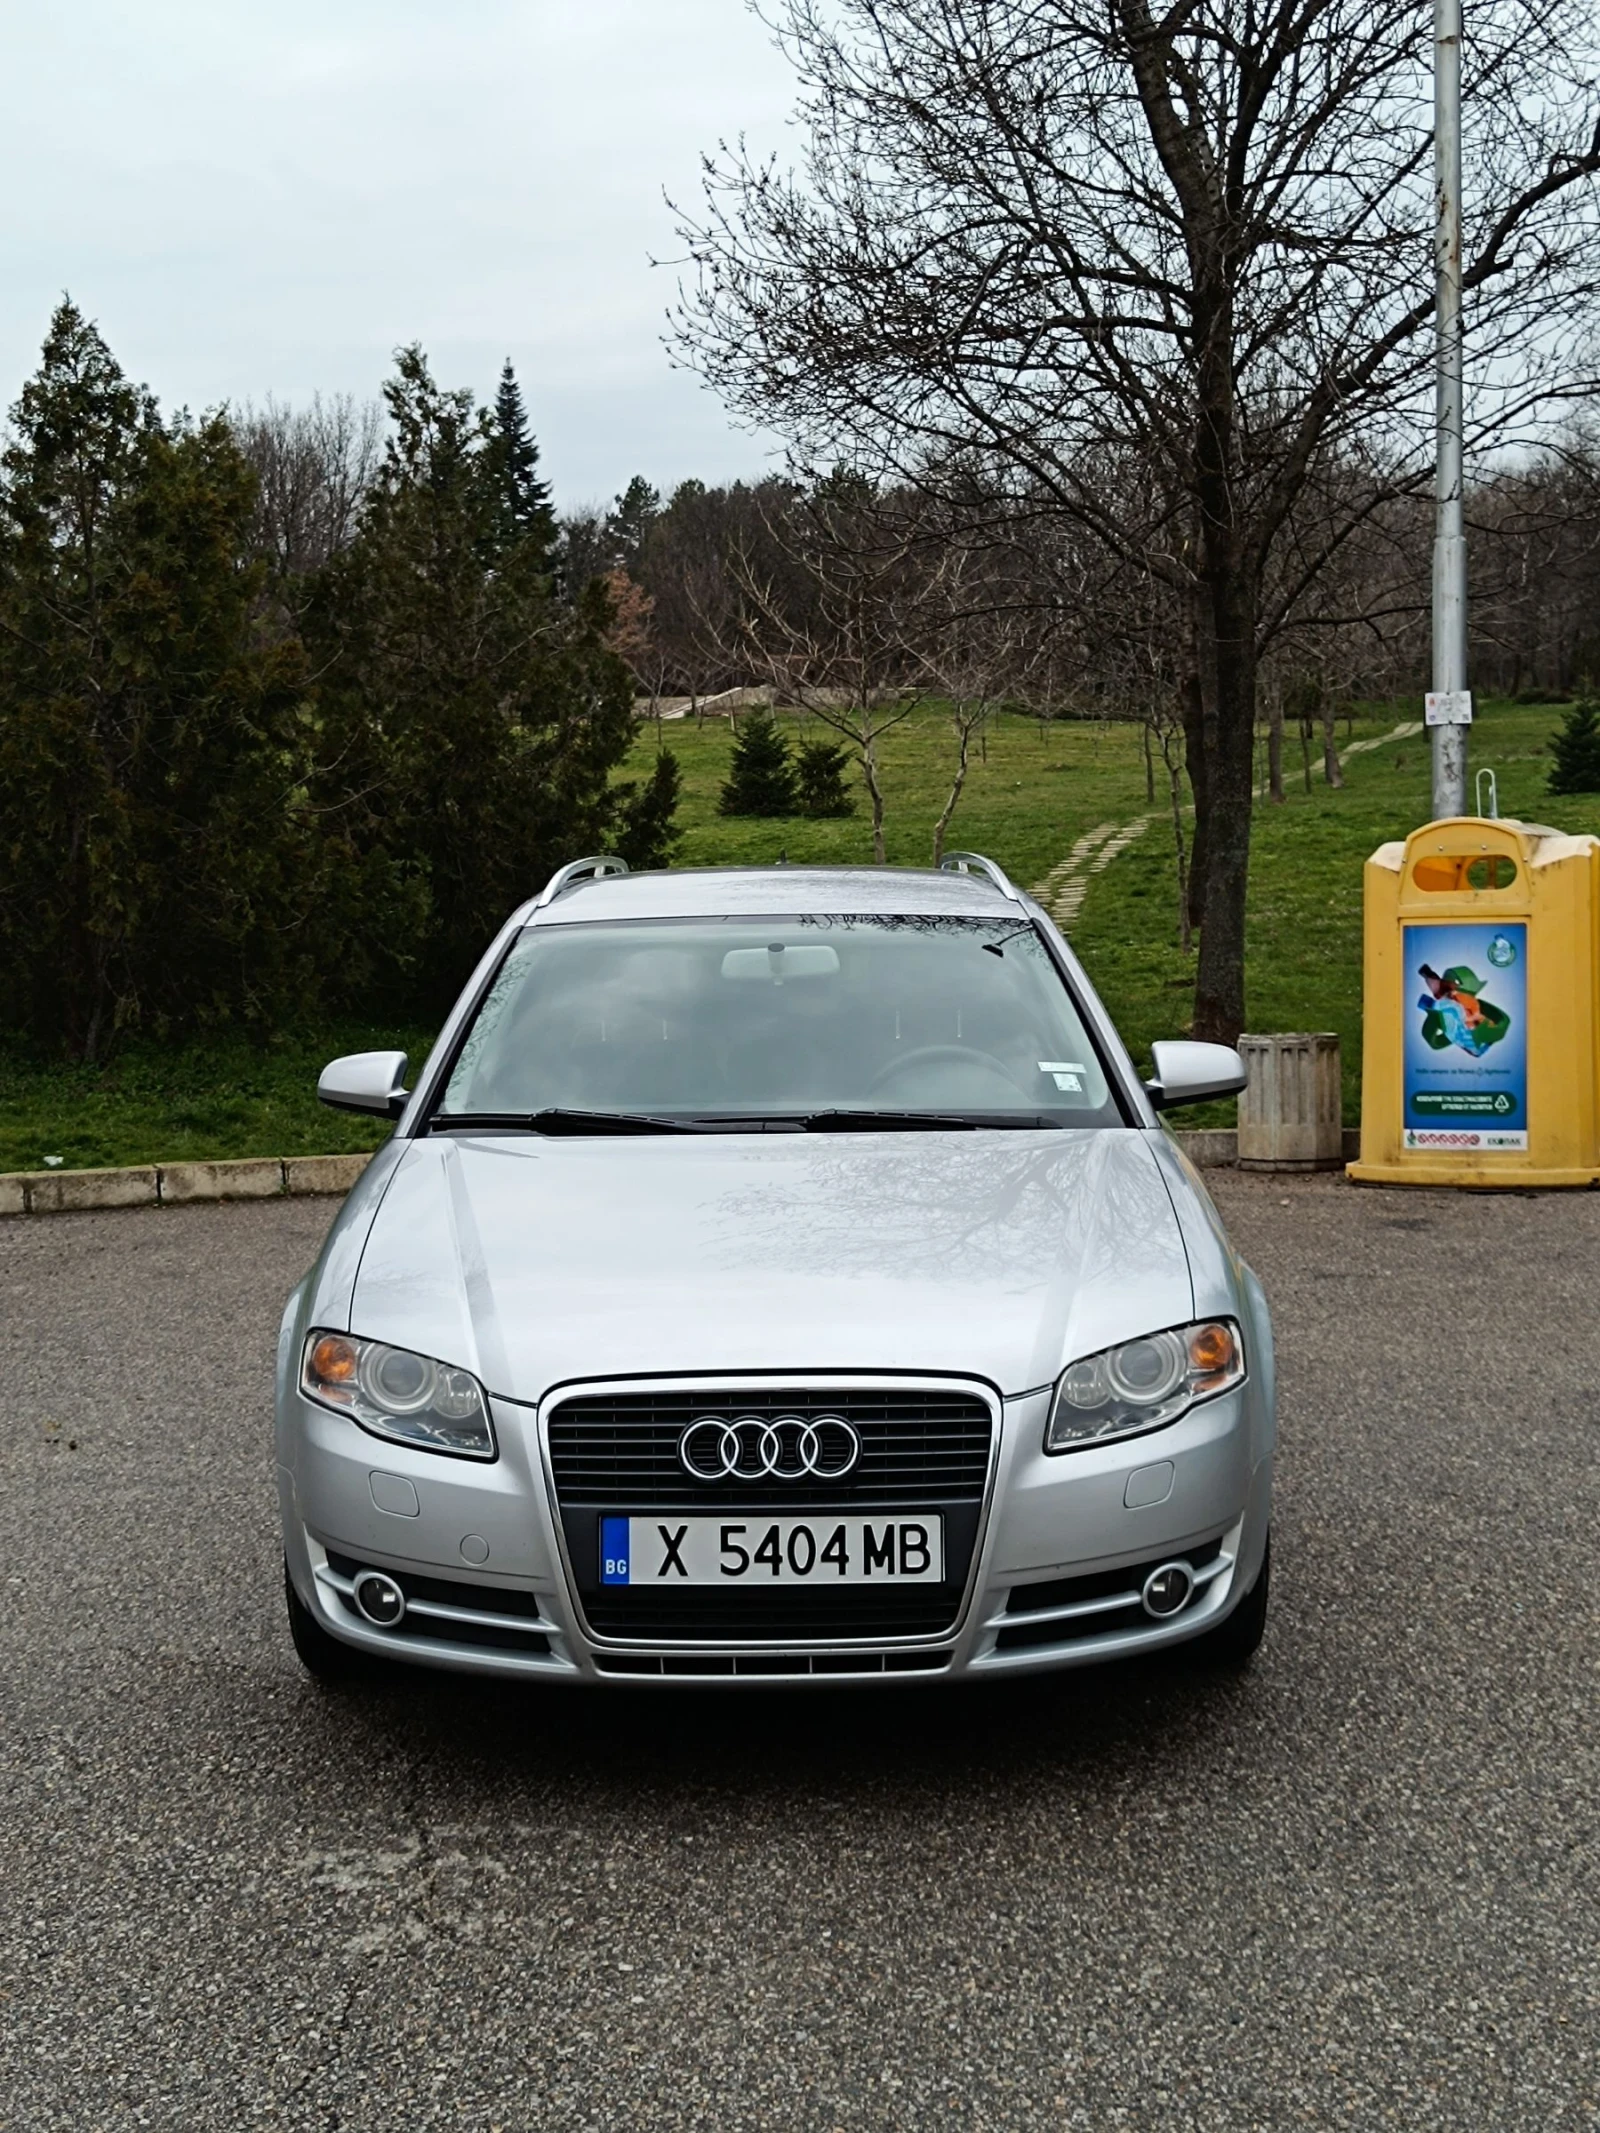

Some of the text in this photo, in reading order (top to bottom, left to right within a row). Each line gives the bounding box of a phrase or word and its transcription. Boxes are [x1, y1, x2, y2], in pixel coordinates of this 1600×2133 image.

[605, 1559, 627, 1575] BG
[657, 1523, 931, 1577] X 5404 MB
